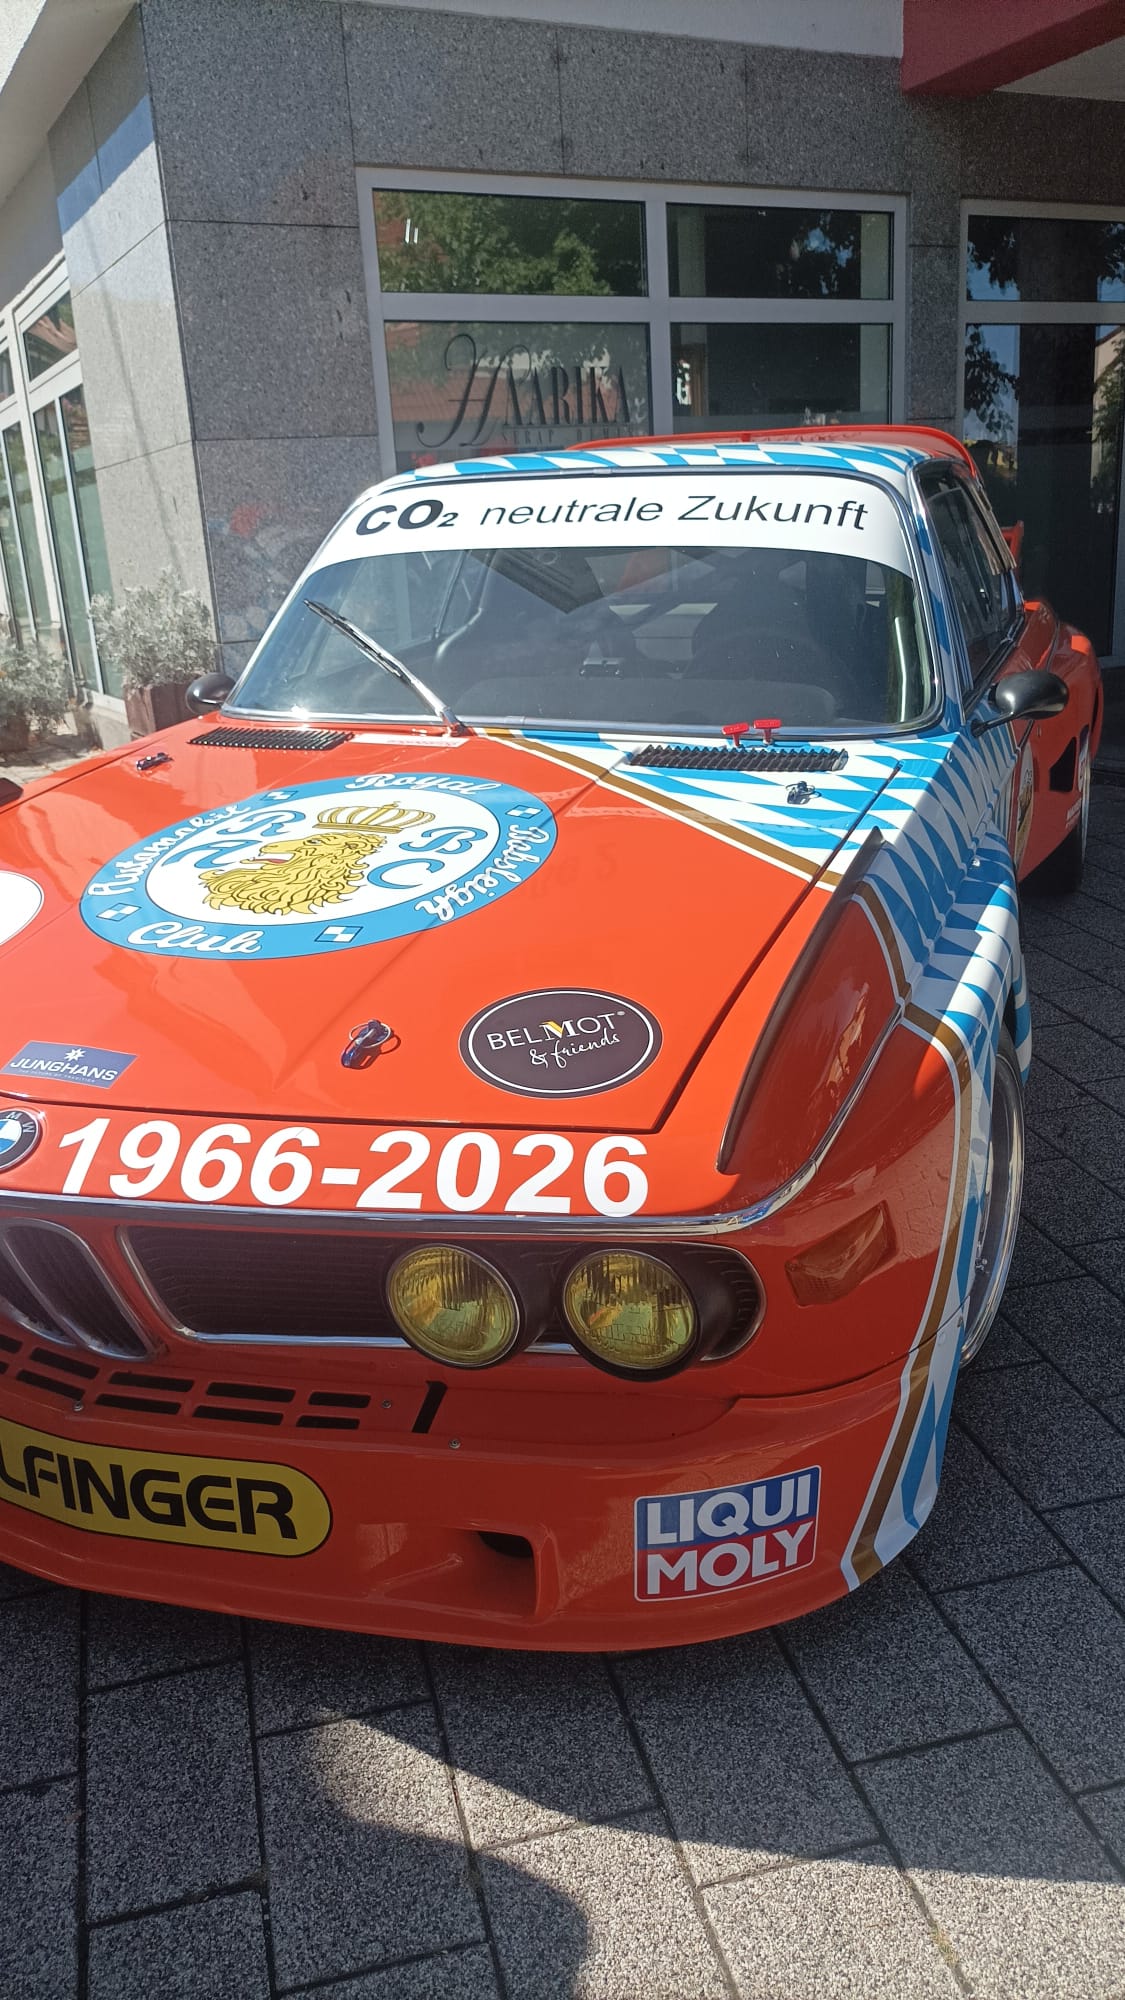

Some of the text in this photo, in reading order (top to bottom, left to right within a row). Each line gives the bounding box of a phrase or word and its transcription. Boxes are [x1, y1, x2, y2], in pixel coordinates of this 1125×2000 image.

[416, 333, 631, 448] HAARIKA
[480, 497, 665, 525] neutrale
[678, 495, 869, 530] Zukunft
[345, 774, 502, 795] Royal
[127, 921, 265, 954] Club
[529, 1028, 621, 1069] & friends
[10, 1058, 118, 1081] JUNGHANS
[57, 1117, 650, 1217] 1966-2026
[647, 1474, 811, 1545] LIQUI
[647, 1521, 813, 1595] MOLY
